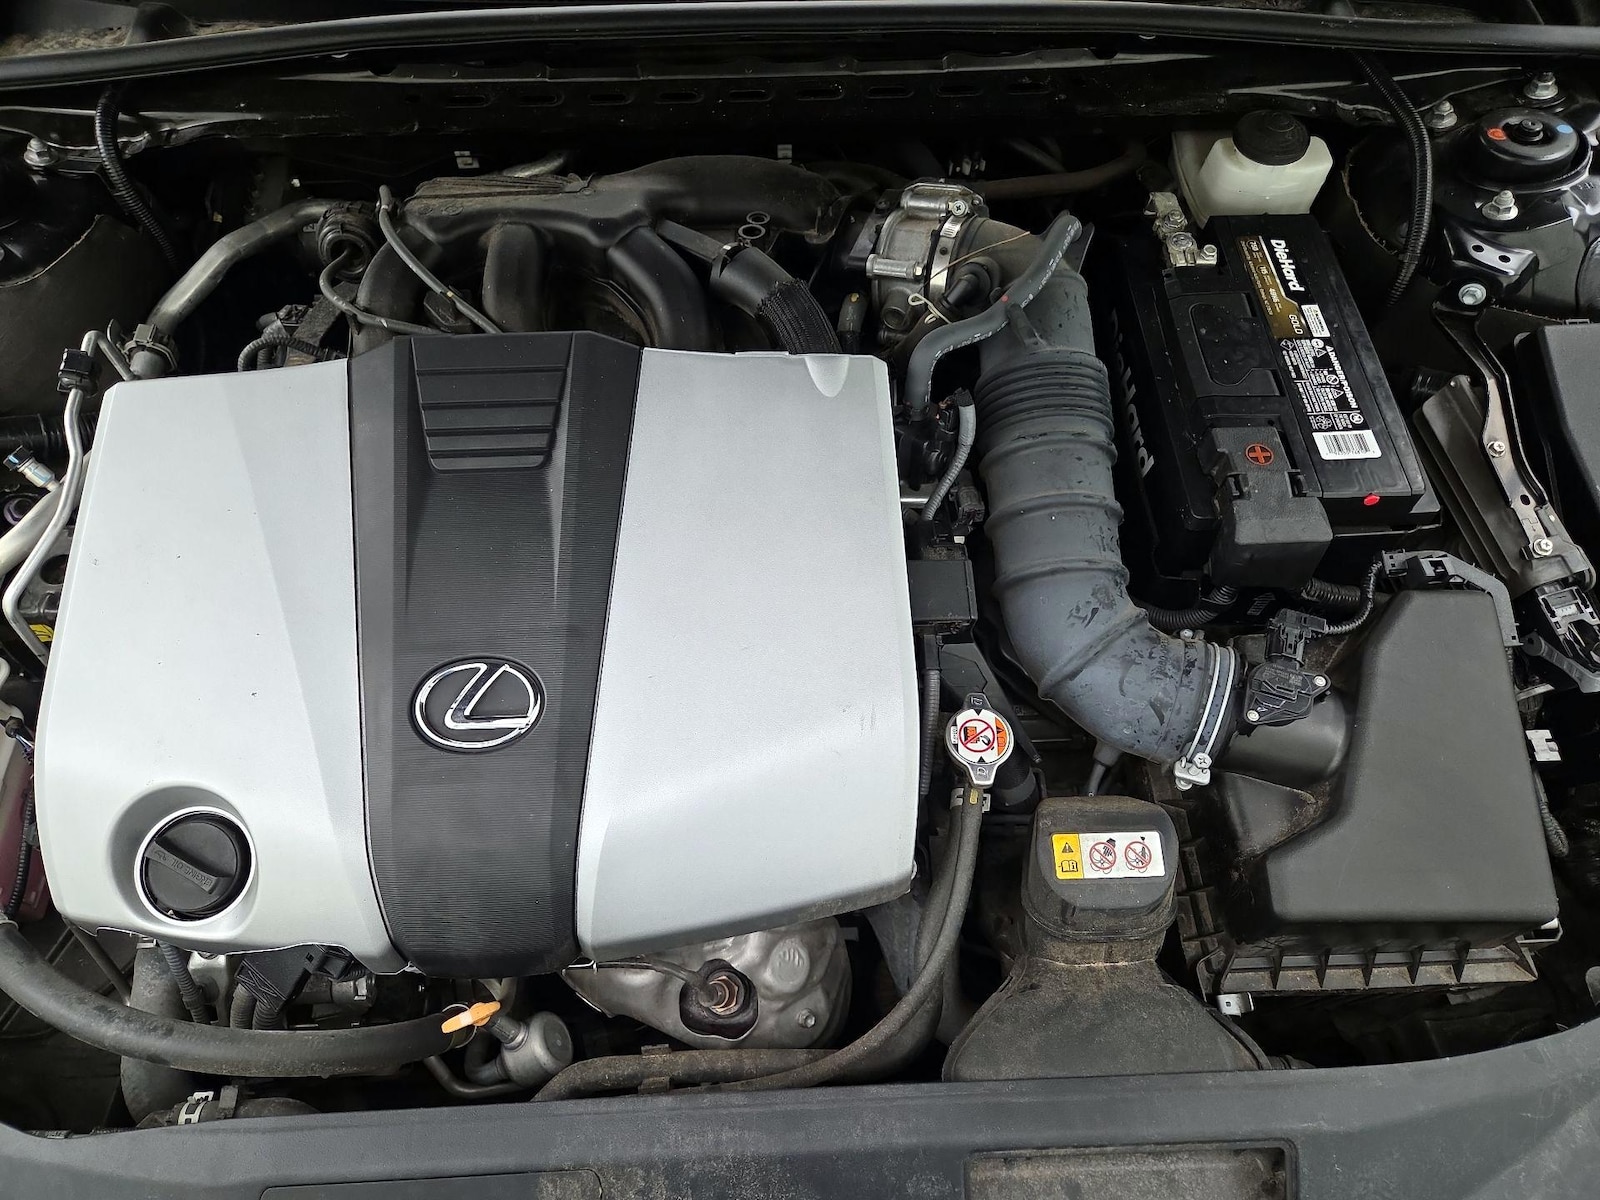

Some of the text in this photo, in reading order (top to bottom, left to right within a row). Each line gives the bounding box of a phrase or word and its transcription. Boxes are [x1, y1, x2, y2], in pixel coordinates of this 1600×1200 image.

[1270, 239, 1305, 291] DieHard
[1288, 313, 1304, 335] GOLD
[171, 858, 213, 887] ENGINE OIL
